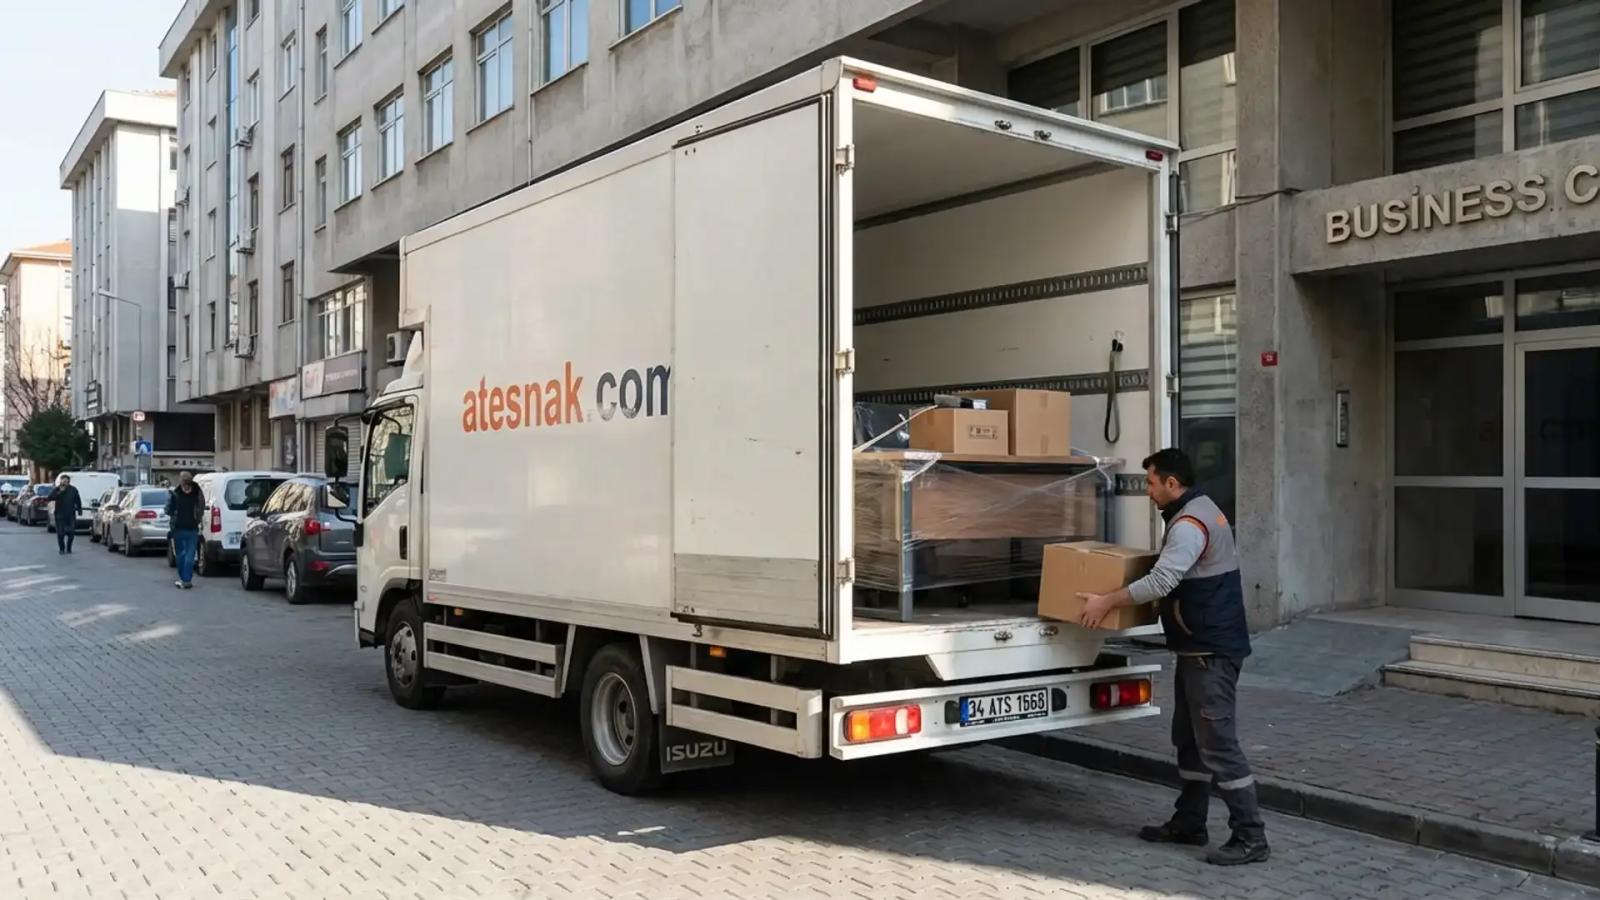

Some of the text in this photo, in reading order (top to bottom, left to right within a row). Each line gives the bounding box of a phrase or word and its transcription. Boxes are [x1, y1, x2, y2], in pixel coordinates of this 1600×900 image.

[1565, 164, 1600, 204] C
[968, 699, 984, 718] 34
[989, 695, 1012, 716] ATS
[666, 740, 727, 763] ISUZU
